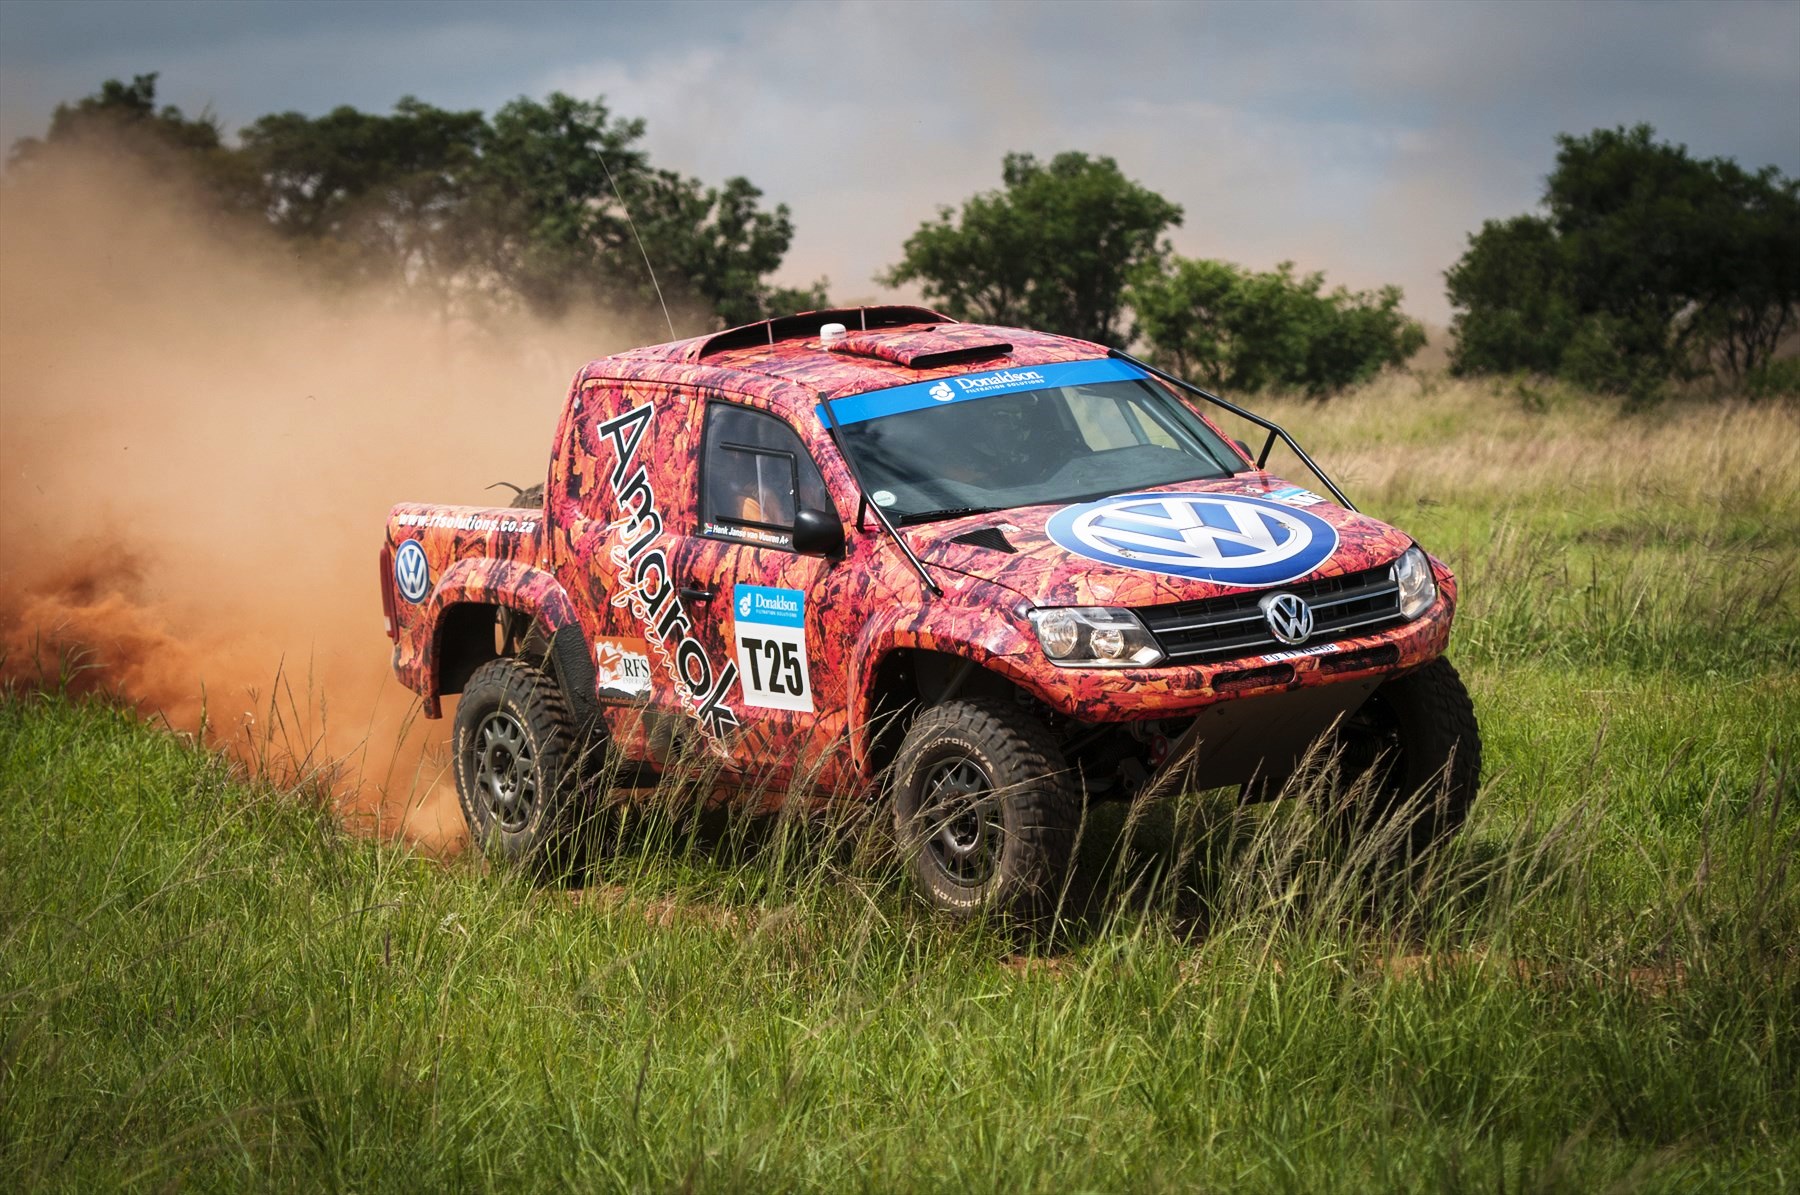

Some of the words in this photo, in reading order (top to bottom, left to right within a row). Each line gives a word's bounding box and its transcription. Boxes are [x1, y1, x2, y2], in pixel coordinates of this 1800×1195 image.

[965, 384, 1005, 394] FILTRATION
[1007, 379, 1045, 388] SOLUTIONS
[597, 401, 741, 750] Amarok
[1267, 593, 1314, 645] VW
[623, 658, 650, 679] RFS
[741, 636, 804, 697] T25
